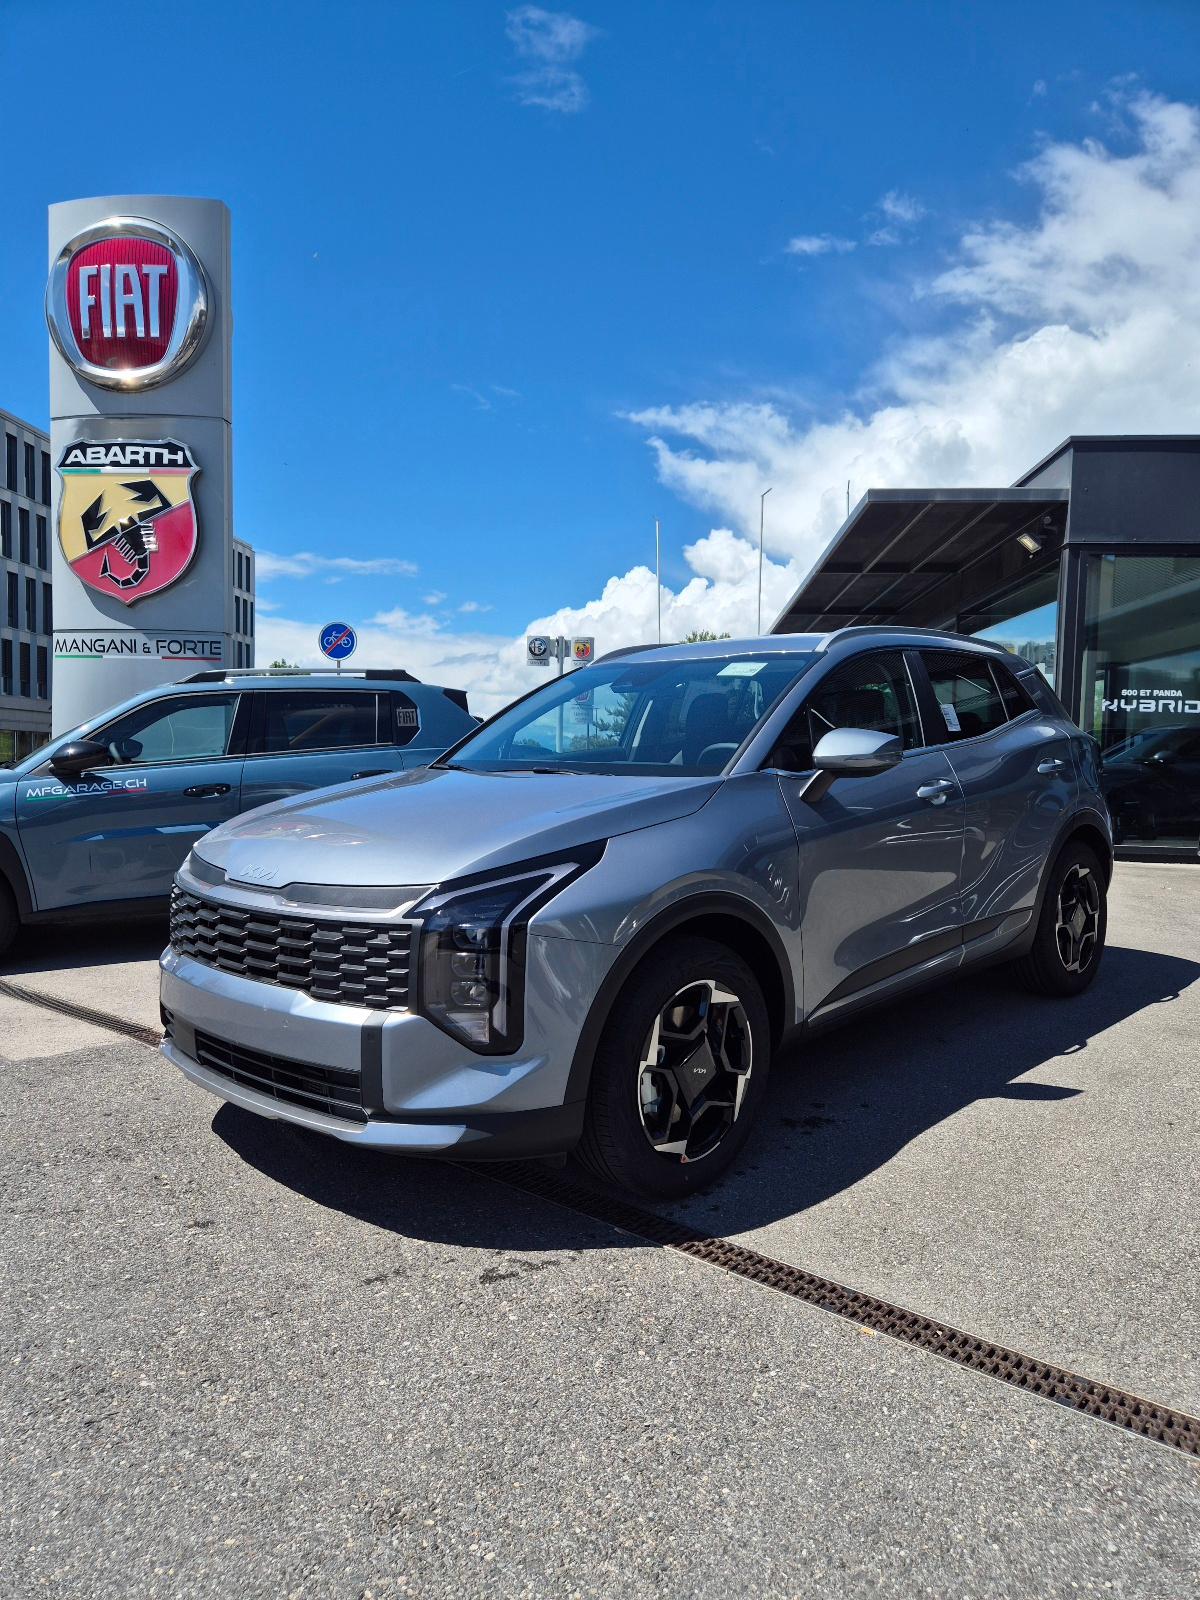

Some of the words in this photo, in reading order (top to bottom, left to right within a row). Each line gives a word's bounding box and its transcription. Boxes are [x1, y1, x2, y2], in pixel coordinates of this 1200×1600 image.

[79, 263, 169, 339] FIAT
[65, 445, 184, 465] ABARTH
[55, 638, 137, 654] MANGANI
[142, 642, 152, 654] &
[156, 639, 222, 656] FORTE
[1140, 689, 1152, 697] ET
[1153, 689, 1183, 697] PANDA
[1101, 699, 1200, 713] HYBRID
[26, 778, 147, 797] MFGARAGE.CH
